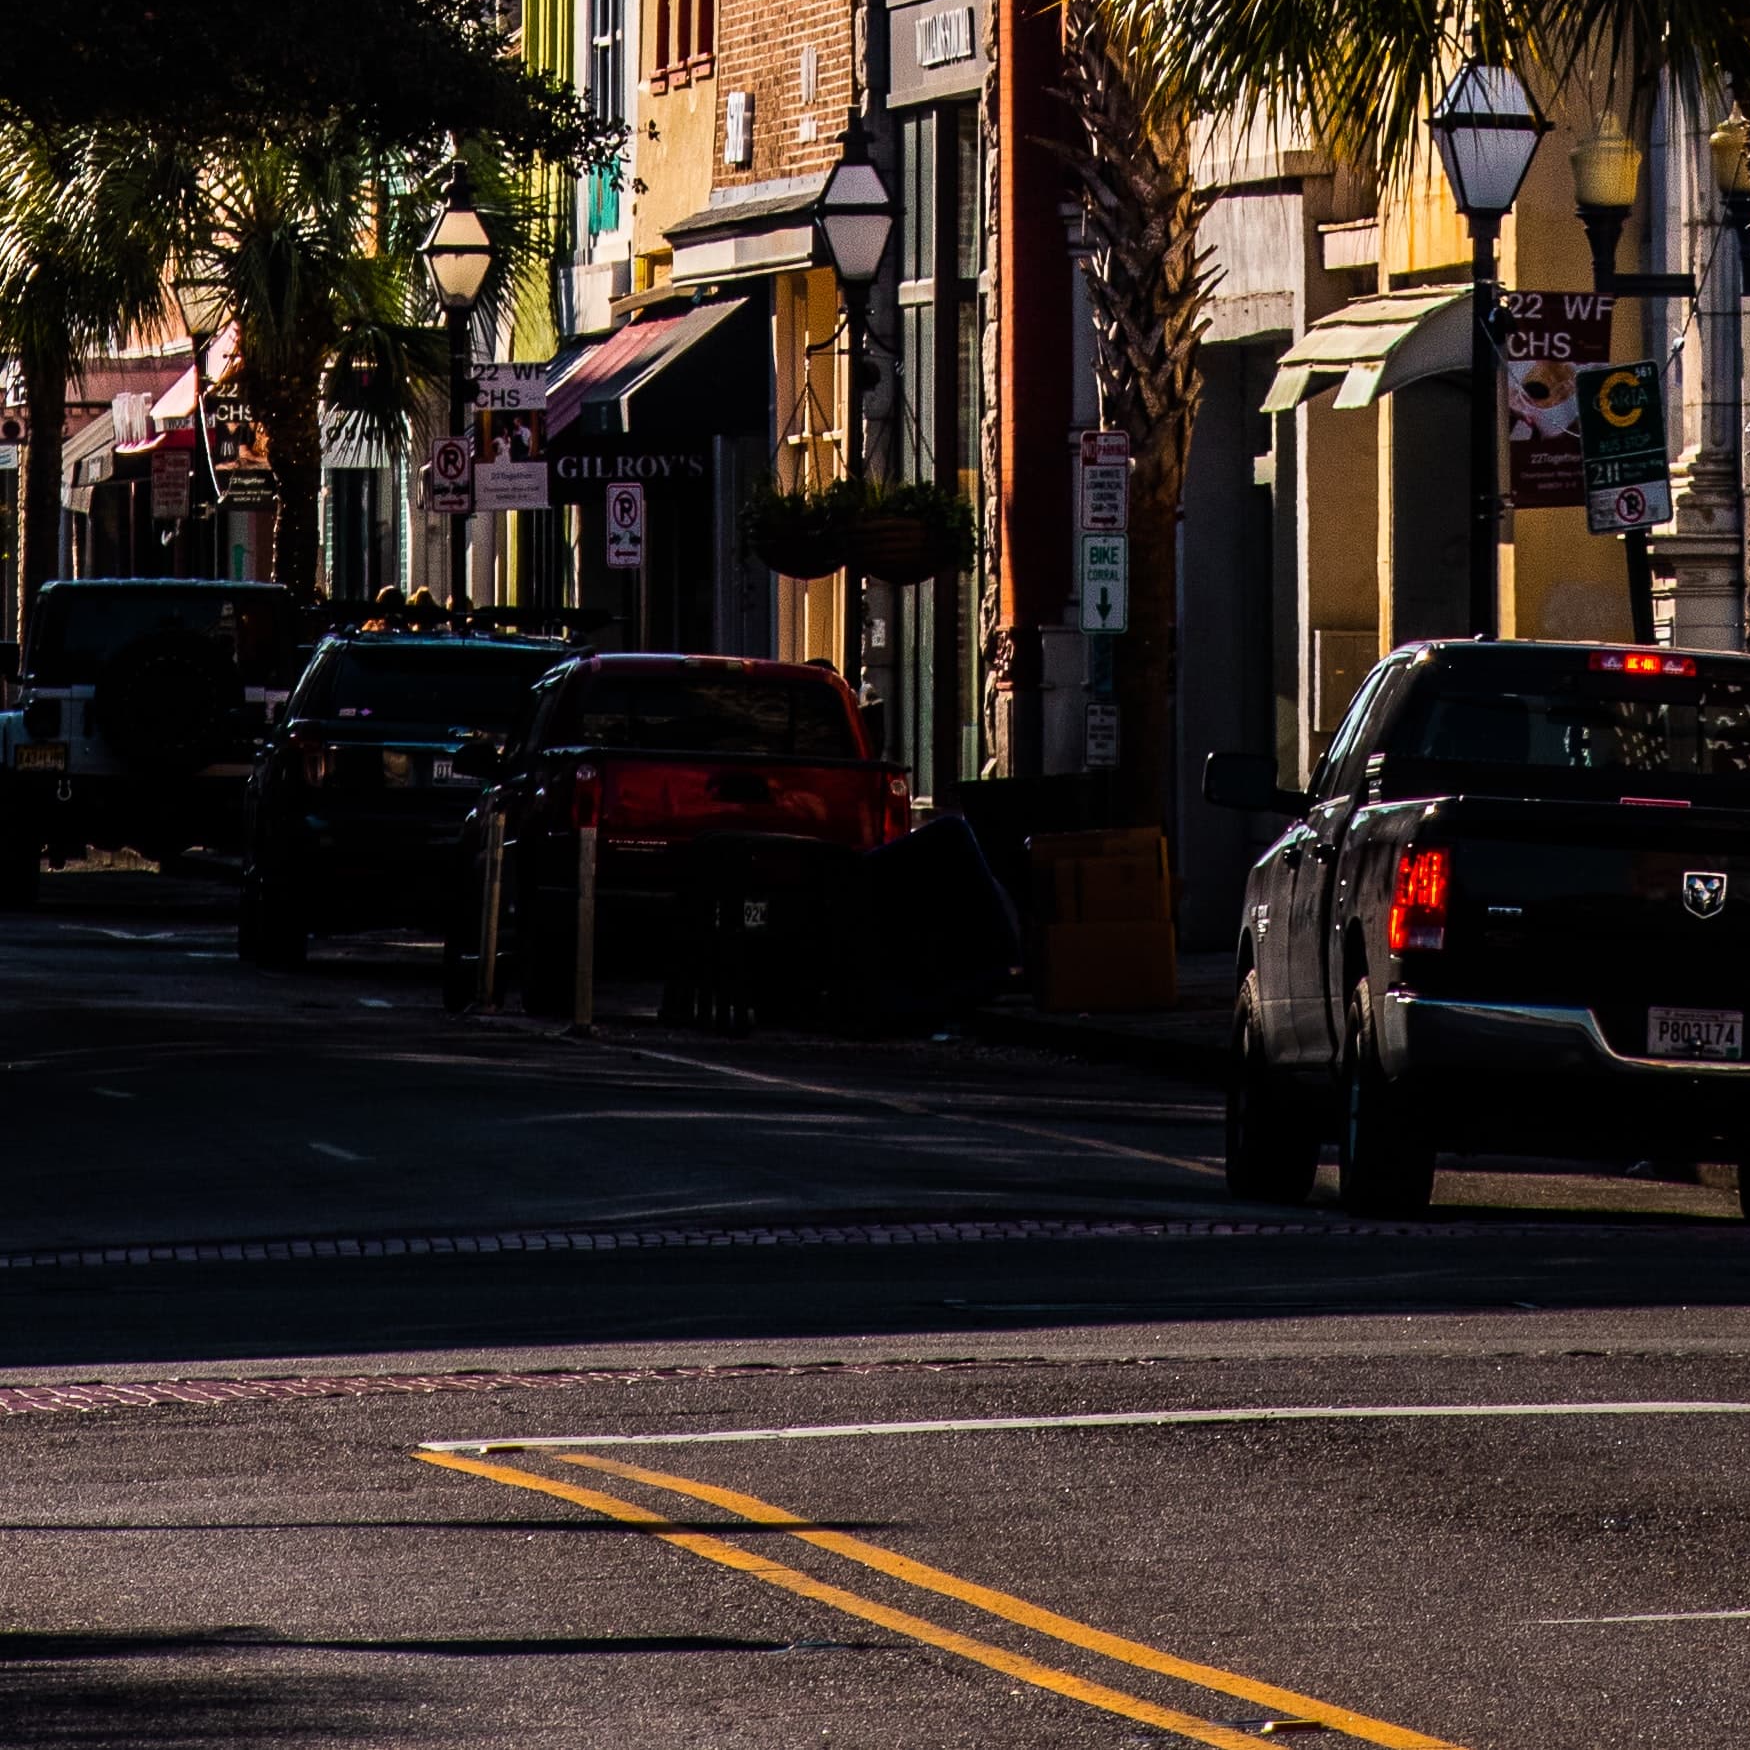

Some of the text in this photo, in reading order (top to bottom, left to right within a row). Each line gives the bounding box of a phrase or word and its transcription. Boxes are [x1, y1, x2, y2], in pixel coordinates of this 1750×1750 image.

[1508, 293, 1544, 319] 22
[1506, 332, 1572, 359] CHS
[474, 363, 500, 381] 22
[475, 389, 521, 408] CHS
[556, 454, 705, 480] GILROY'S
[1090, 546, 1120, 565] BIKE
[1087, 569, 1120, 581] CORRAL
[1659, 1021, 1735, 1046] P803174
